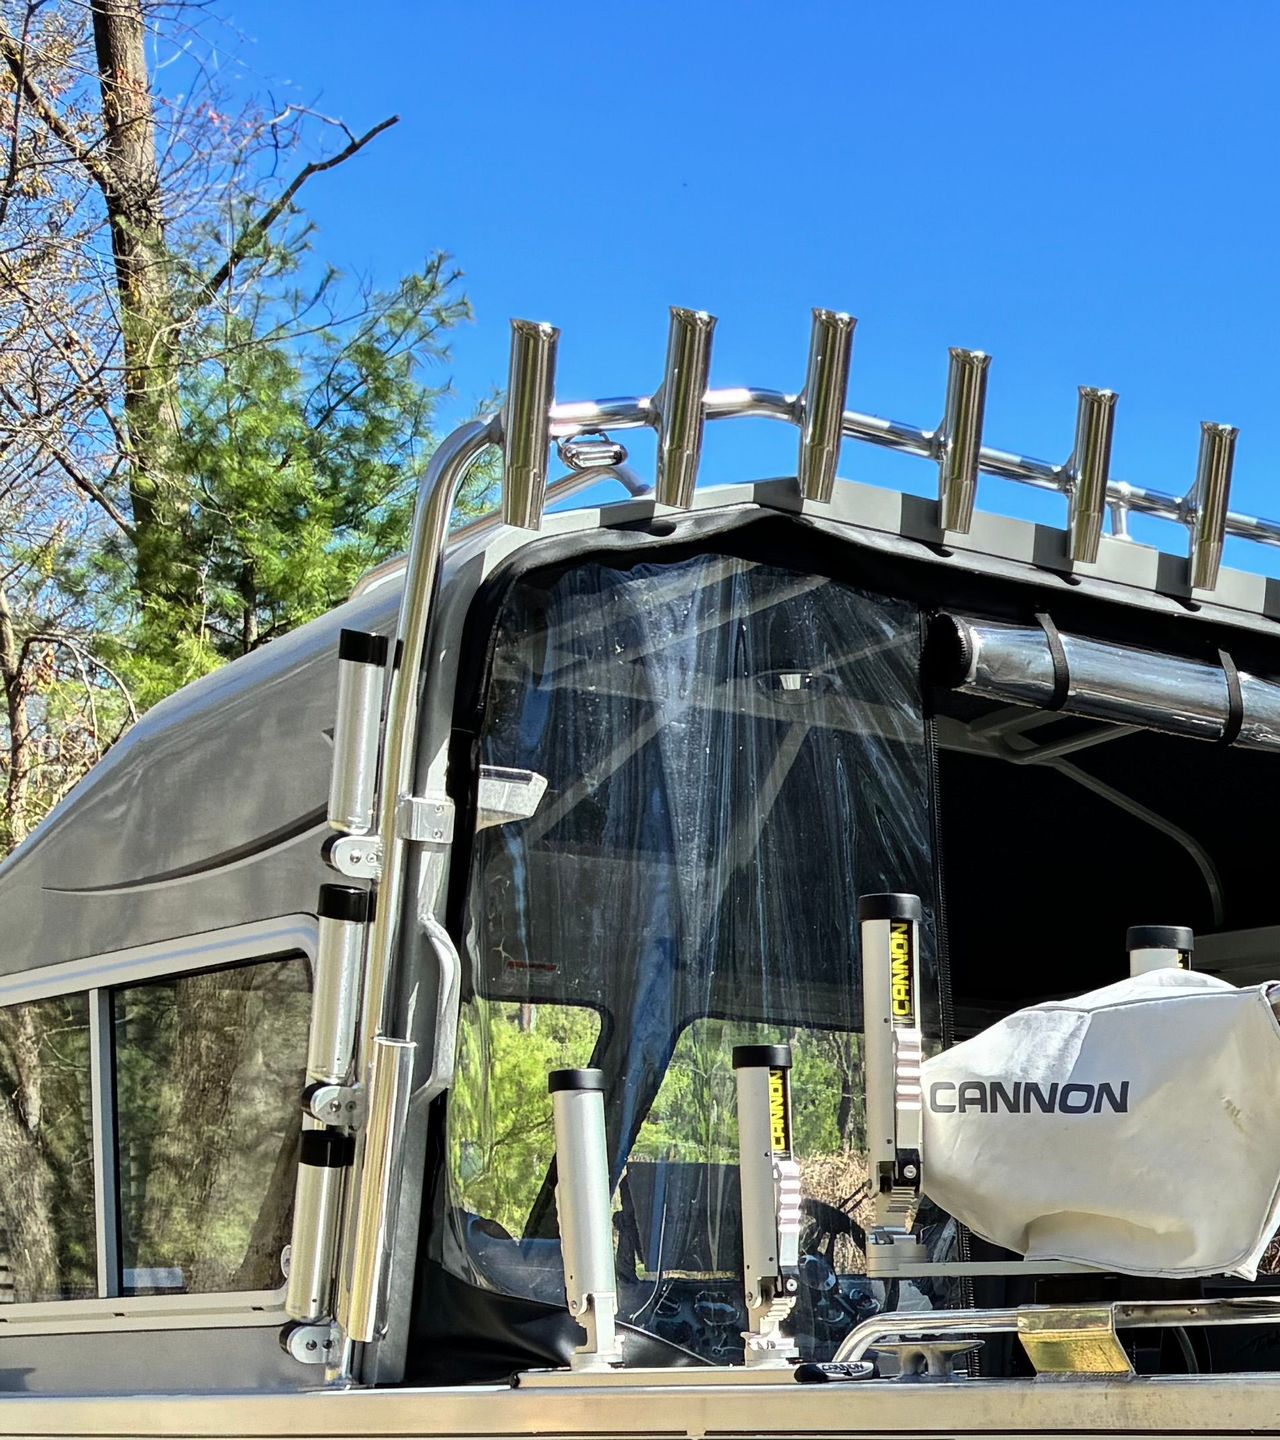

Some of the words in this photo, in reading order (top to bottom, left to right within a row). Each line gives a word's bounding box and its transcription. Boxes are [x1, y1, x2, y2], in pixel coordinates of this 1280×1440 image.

[891, 922, 910, 1015] CANNON
[769, 1069, 785, 1151] CANNON
[929, 1080, 1130, 1114] CANNON
